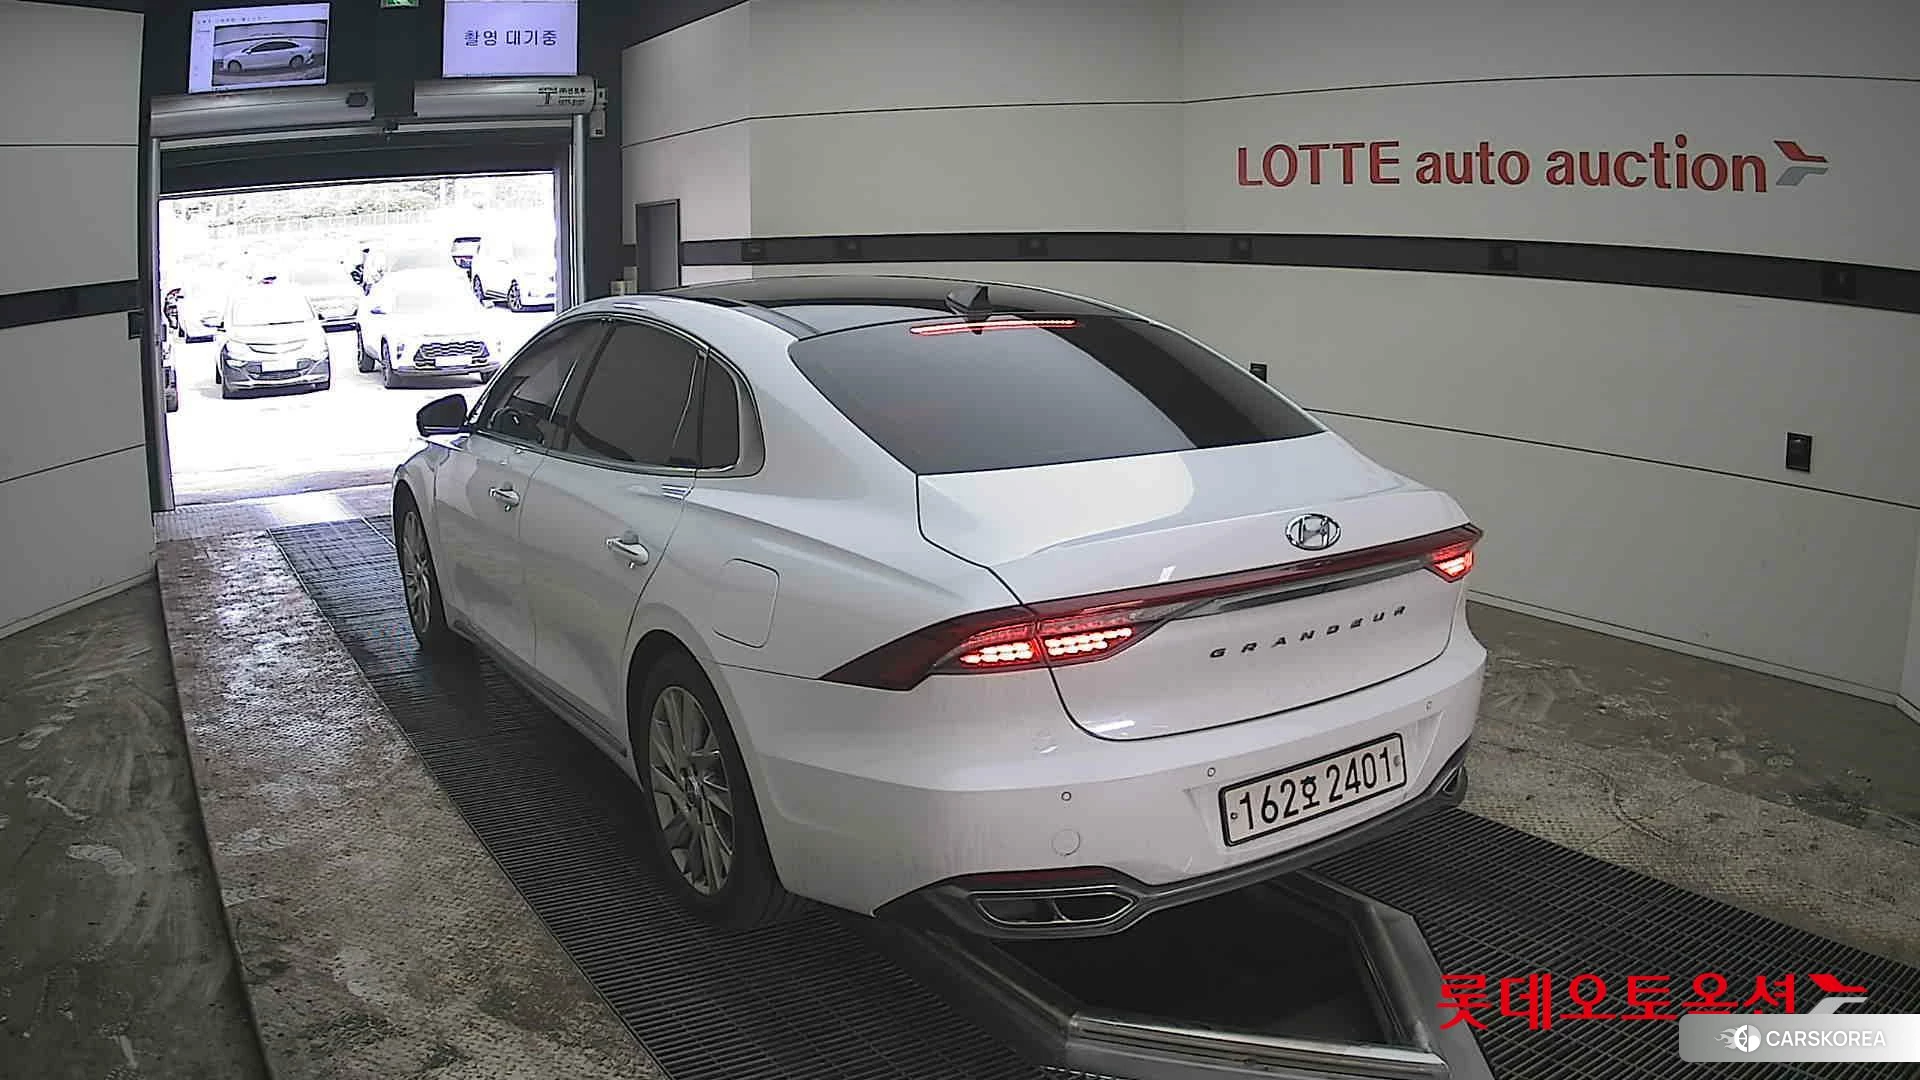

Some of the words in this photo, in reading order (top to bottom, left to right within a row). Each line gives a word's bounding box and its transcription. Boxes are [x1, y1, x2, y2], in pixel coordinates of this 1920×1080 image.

[506, 29, 557, 46] 대기중
[1237, 141, 1400, 187] LOTTE
[1415, 141, 1531, 186] auto
[1546, 134, 1768, 193] auction
[1209, 604, 1407, 659] GRANDEUR
[1326, 747, 1392, 803] 2401
